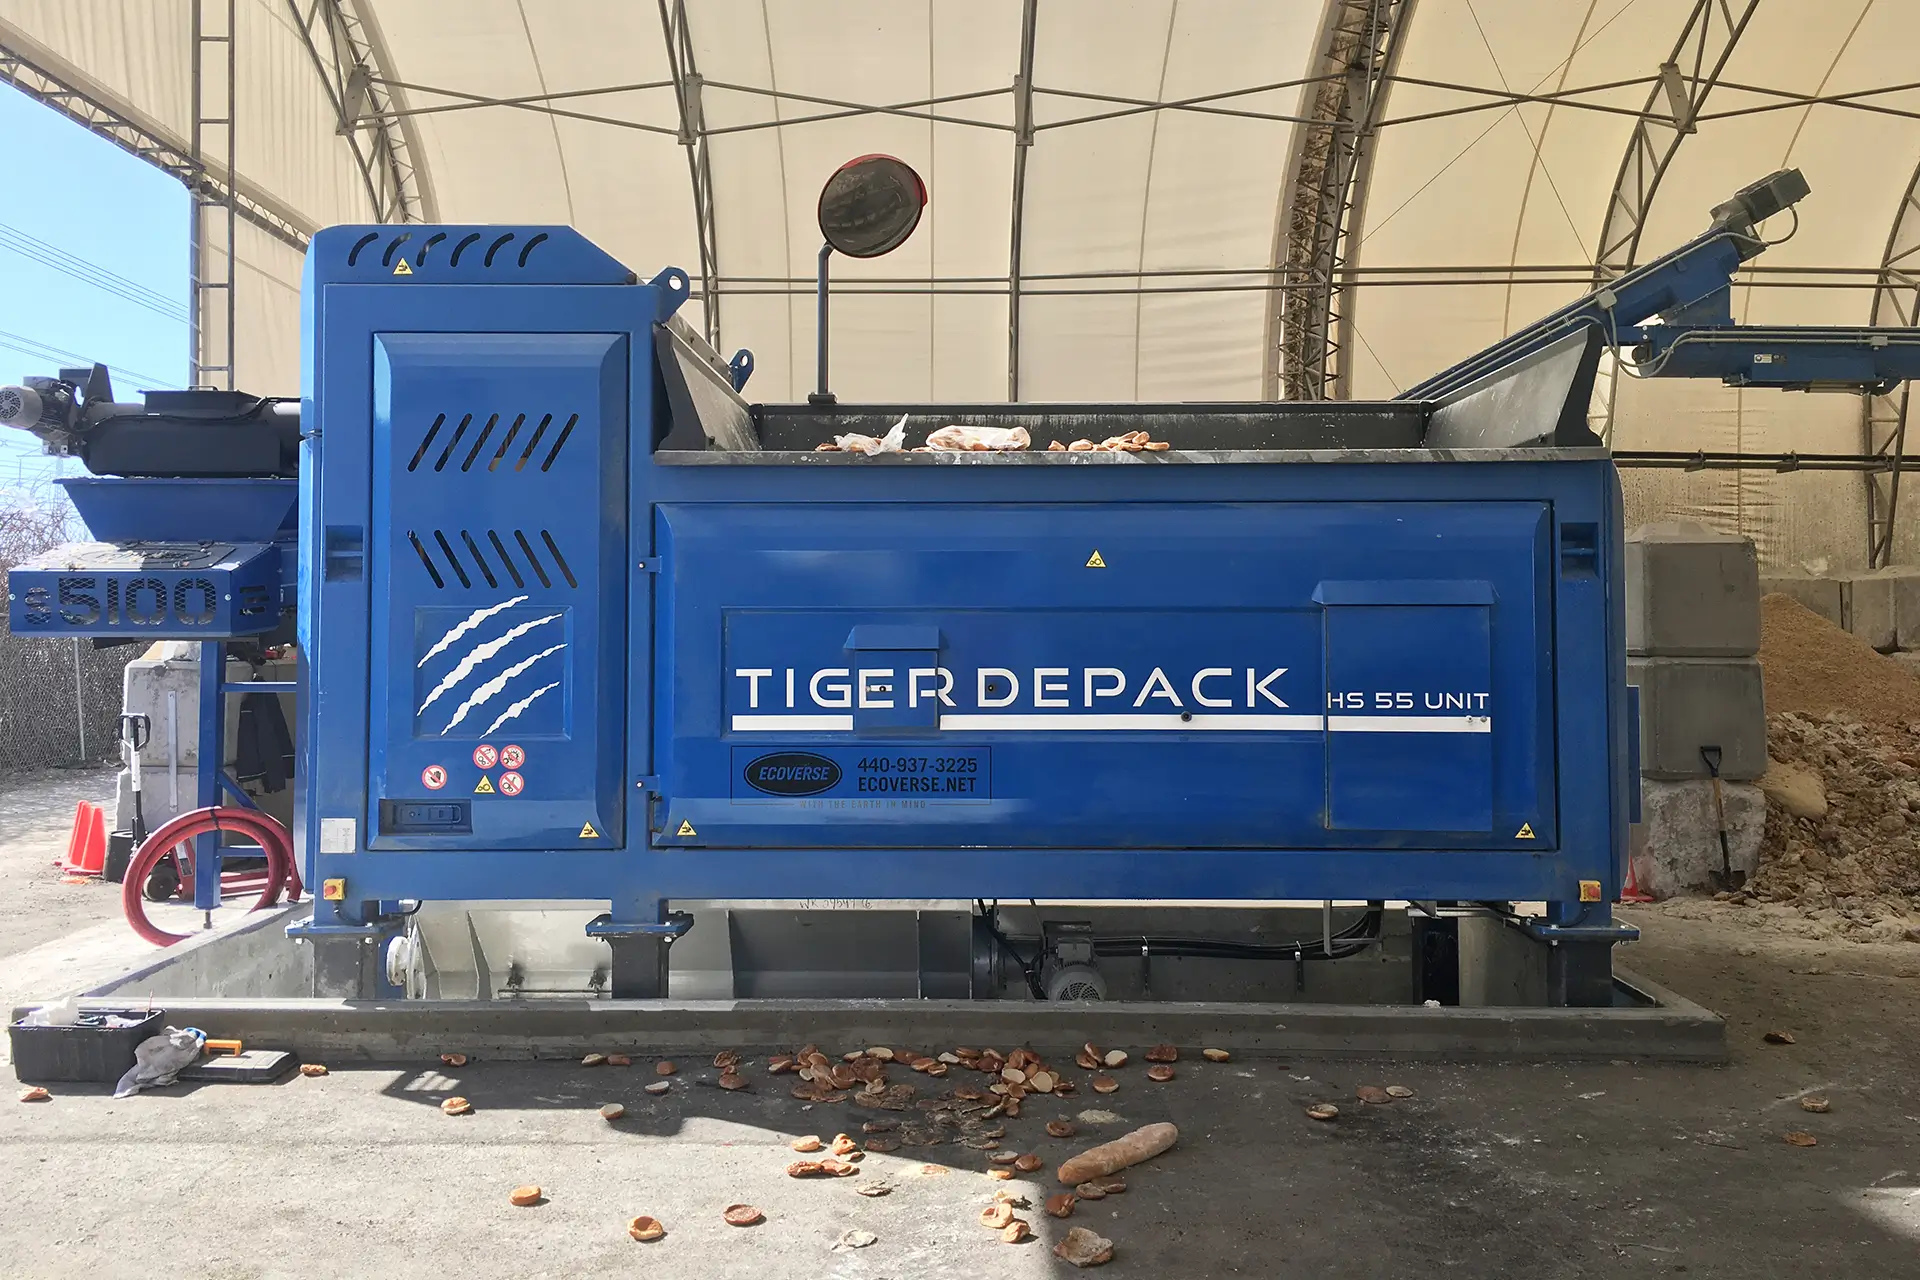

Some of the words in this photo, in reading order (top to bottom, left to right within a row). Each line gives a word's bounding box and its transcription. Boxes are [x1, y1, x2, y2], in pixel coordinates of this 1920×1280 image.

[735, 667, 957, 708] TIGER
[977, 667, 1290, 708] DEPACK
[1327, 692, 1364, 709] HS
[1375, 692, 1414, 709] 55
[1424, 692, 1489, 709] UNIT
[857, 757, 978, 773] 440-937-3225
[758, 766, 831, 781] ECOVERSE
[857, 777, 977, 793] ECOVERSE.NET
[799, 800, 824, 809] WITH
[828, 800, 847, 809] THE
[851, 800, 881, 809] EARTH
[886, 800, 896, 809] IN
[901, 800, 926, 809] MIND
